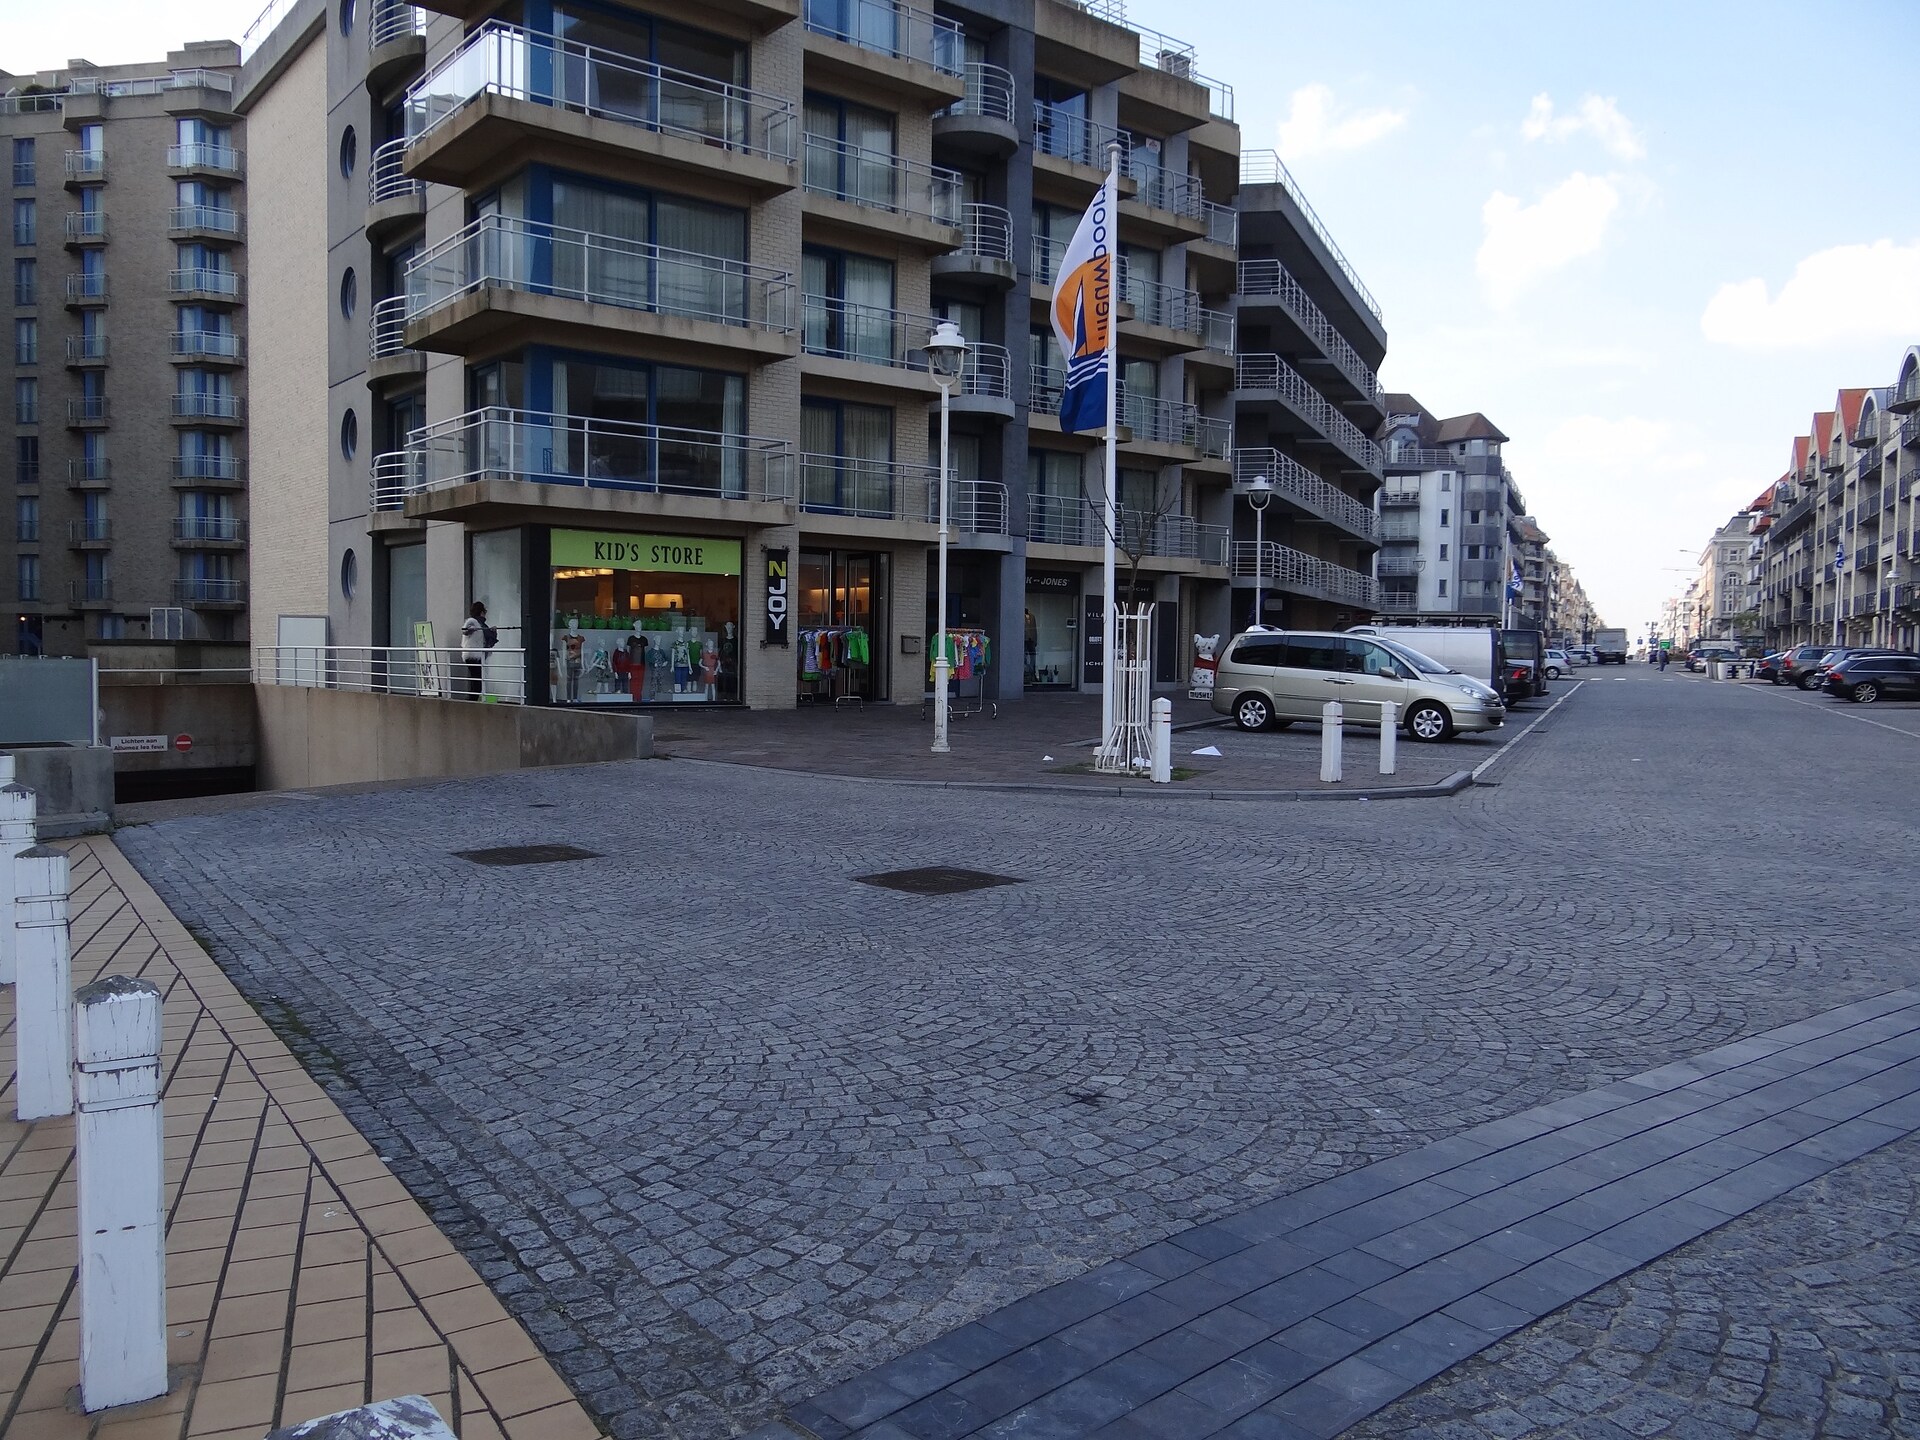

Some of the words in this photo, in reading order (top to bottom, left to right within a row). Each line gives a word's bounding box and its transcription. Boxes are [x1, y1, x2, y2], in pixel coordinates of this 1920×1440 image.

[594, 541, 639, 561] KID'S
[651, 545, 704, 566] STORE
[1041, 577, 1068, 587] JONES
[768, 561, 787, 630] NJOY
